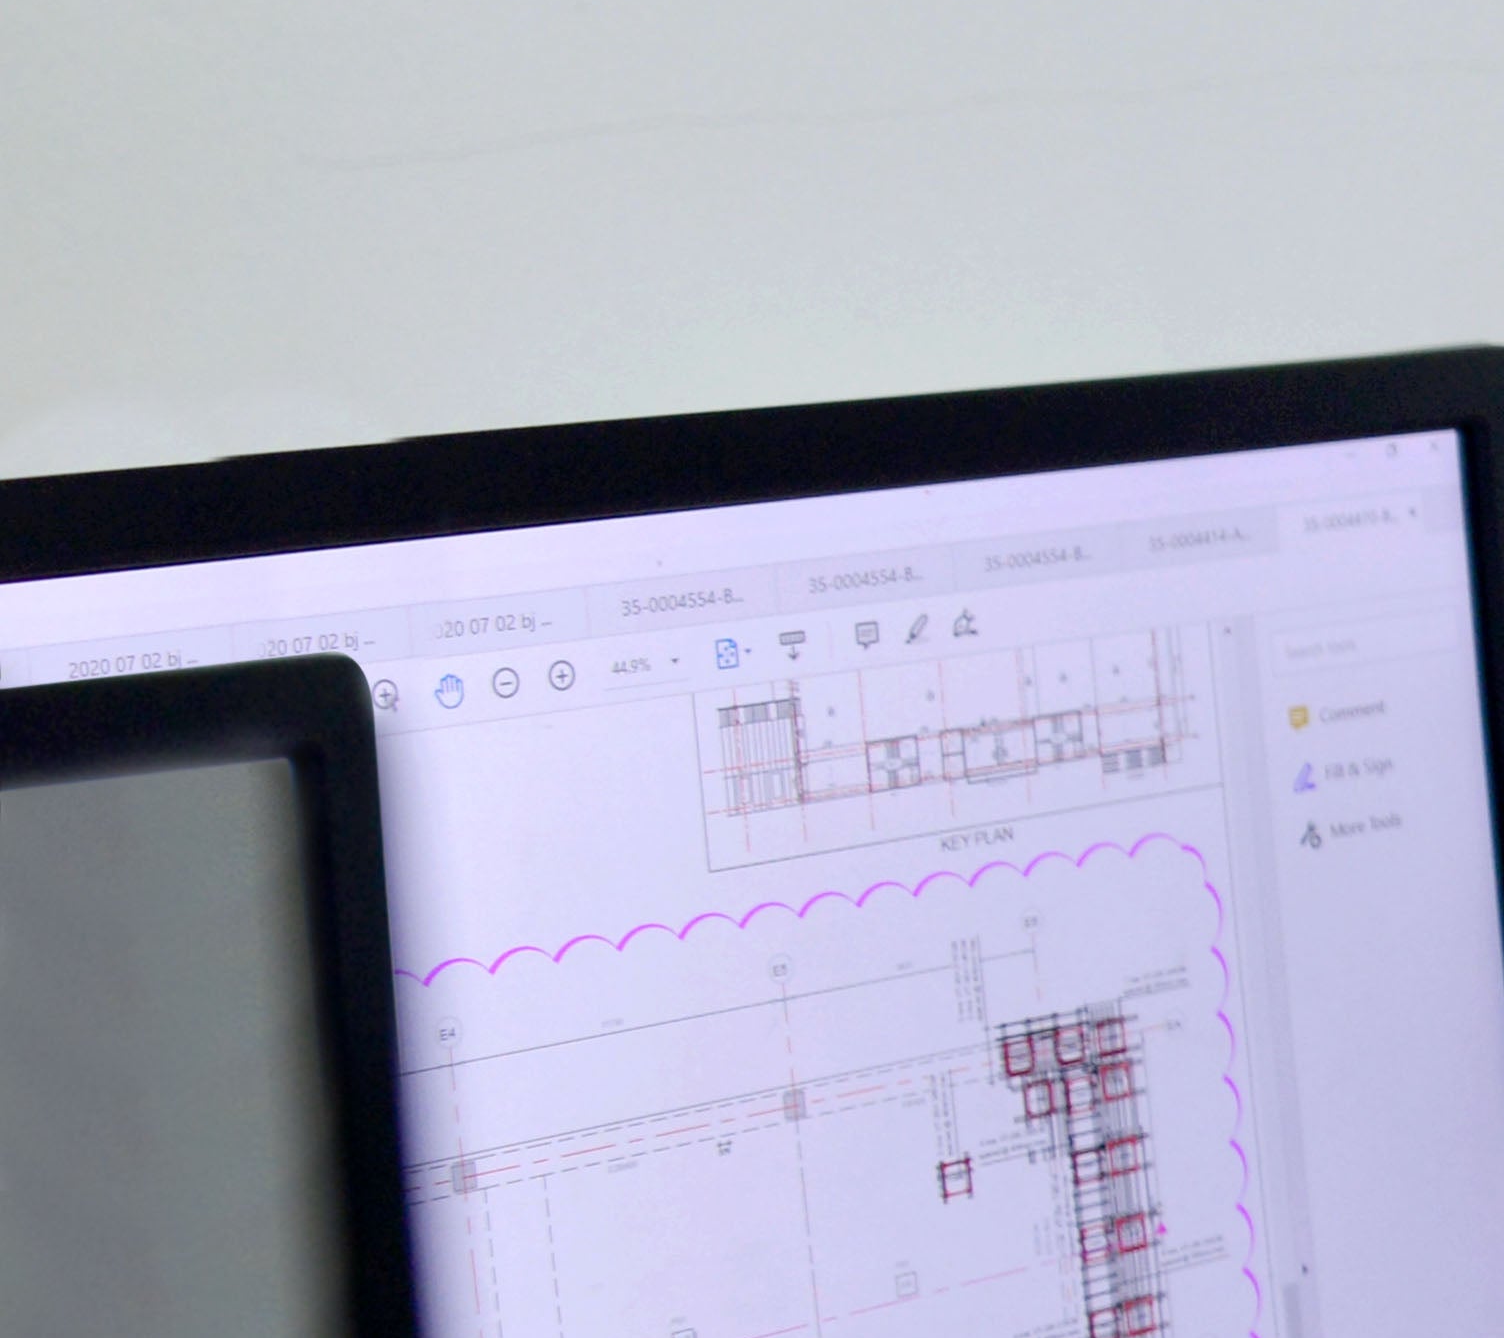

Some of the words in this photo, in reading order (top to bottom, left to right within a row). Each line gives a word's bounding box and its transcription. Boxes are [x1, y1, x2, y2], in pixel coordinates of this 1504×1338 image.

[470, 617, 489, 635] 07
[496, 615, 516, 632] 02
[294, 636, 312, 654] 07
[319, 633, 338, 650] 02
[69, 658, 110, 679] 2020
[116, 656, 135, 673] 07
[141, 652, 162, 669] 02
[1319, 700, 1385, 723] Comment
[1330, 820, 1365, 839] More
[1369, 812, 1402, 830] Tools
[940, 832, 971, 852] KEY
[975, 827, 1014, 848] PLAN
